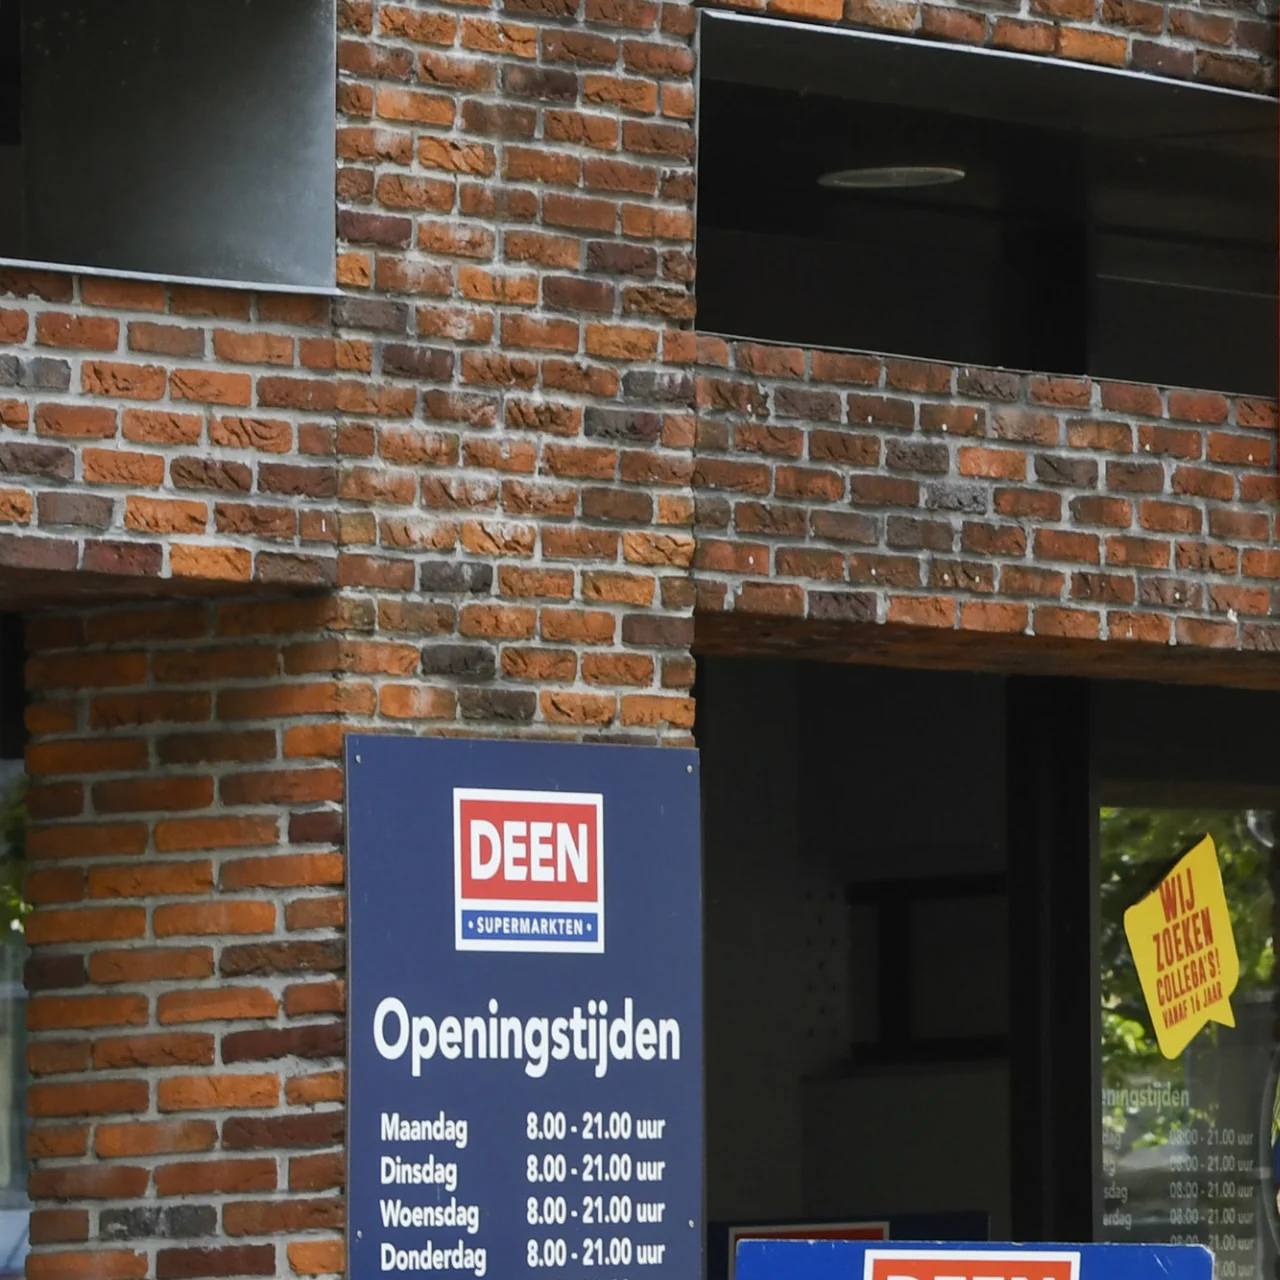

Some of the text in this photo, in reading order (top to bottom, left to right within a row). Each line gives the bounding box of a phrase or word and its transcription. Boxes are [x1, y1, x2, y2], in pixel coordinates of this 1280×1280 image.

[470, 819, 588, 883] DEEN
[1159, 867, 1196, 924] WIJ
[476, 916, 584, 935] SUPERMARKTEN
[1152, 906, 1214, 973] ZOEKEN
[1156, 947, 1222, 1007] COLLEGA'S!
[1162, 981, 1224, 1029] VANAF 16 JAAR
[373, 996, 681, 1078] Openingstijden
[380, 1110, 468, 1148] Maandag
[526, 1112, 567, 1140] 8.00
[582, 1111, 631, 1139] 21.00
[636, 1118, 666, 1138] uur
[1237, 1132, 1254, 1146] uur
[380, 1154, 458, 1191] Dinsdag
[526, 1154, 567, 1182] 8.00
[582, 1153, 631, 1181] 21.00
[636, 1160, 666, 1181] uur
[1237, 1159, 1254, 1171] uur
[1237, 1185, 1254, 1198] uur
[380, 1197, 479, 1234] Woensdag
[526, 1196, 567, 1224] 8.00
[582, 1195, 632, 1223] 21.00
[636, 1202, 666, 1223] uur
[1237, 1212, 1254, 1224] uur
[380, 1240, 486, 1277] Donderdag
[527, 1239, 567, 1267] 8.00
[582, 1237, 632, 1265] 21.00
[636, 1243, 666, 1264] uur
